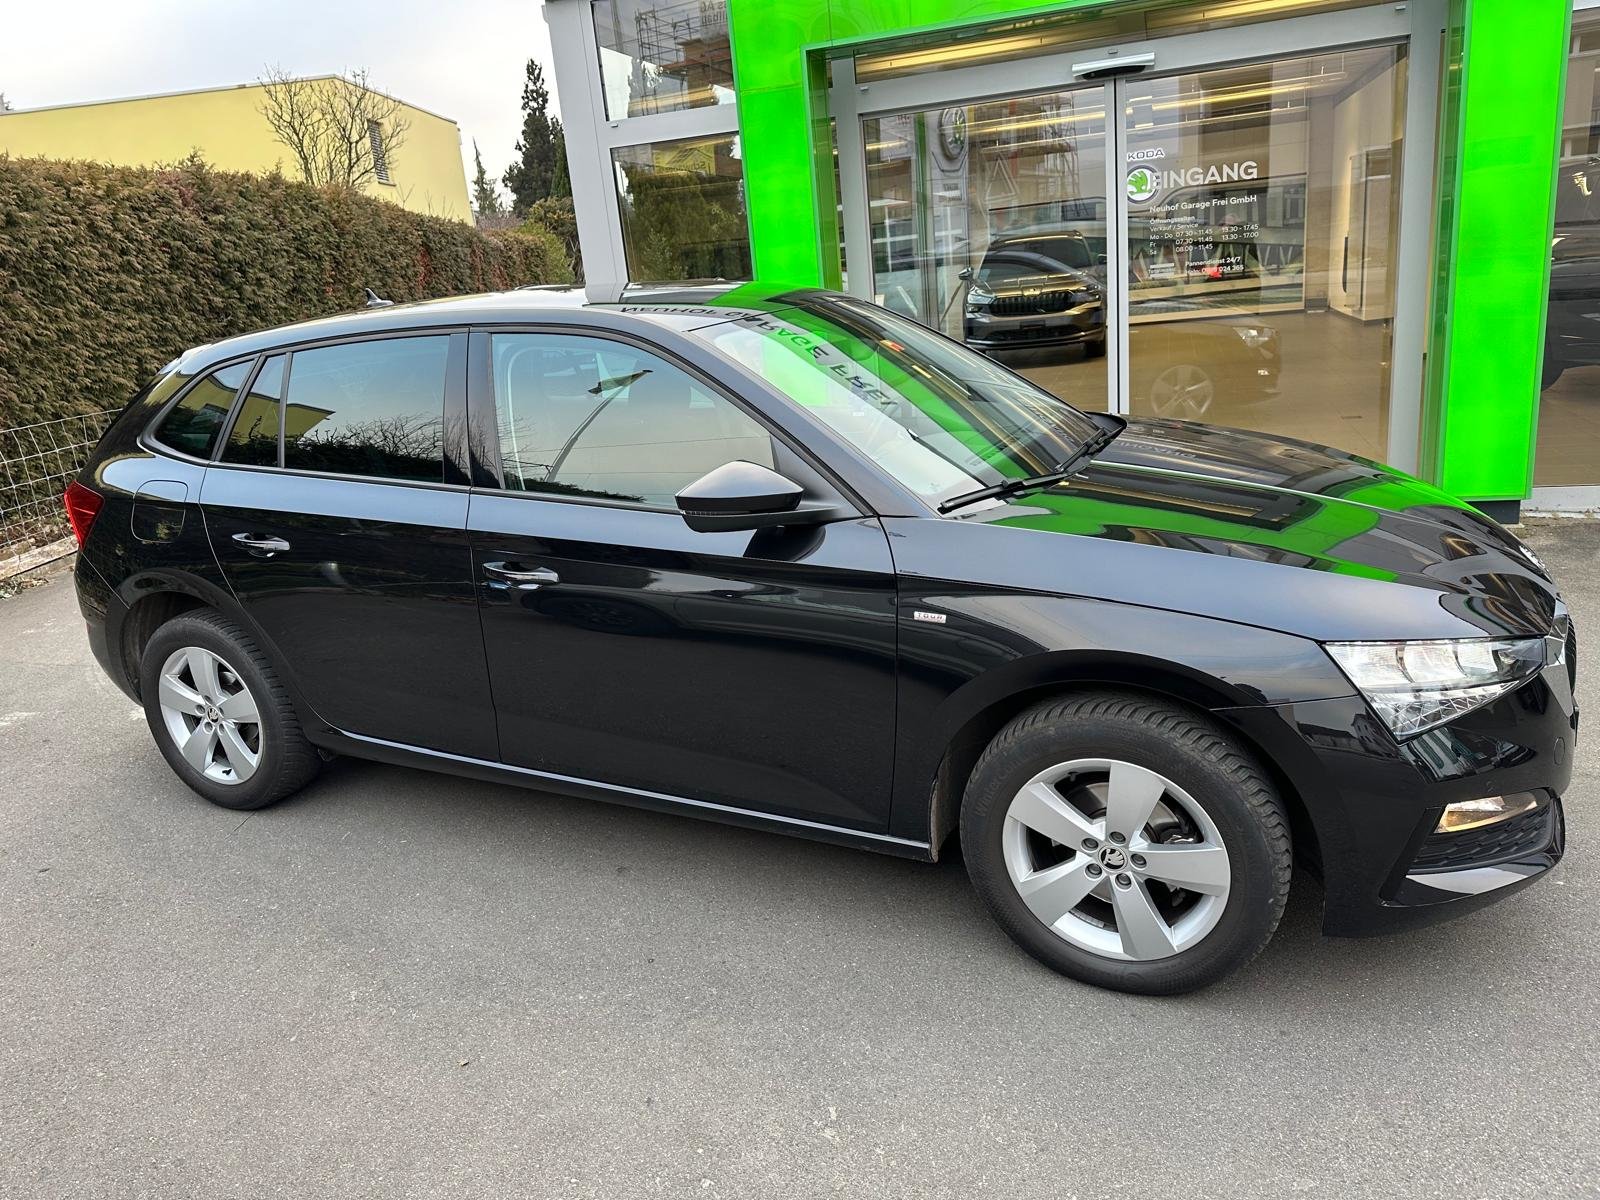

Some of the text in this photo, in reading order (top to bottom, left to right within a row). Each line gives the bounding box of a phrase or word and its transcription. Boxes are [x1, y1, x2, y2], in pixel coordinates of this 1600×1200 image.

[1127, 149, 1165, 161] KODA
[1149, 160, 1258, 189] EINGANG
[1149, 195, 1257, 213] Neuhof Garage Frei GmbH
[1221, 233, 1238, 241] 13.30
[1243, 231, 1259, 239] 17.00
[1226, 256, 1241, 264] 24/7
